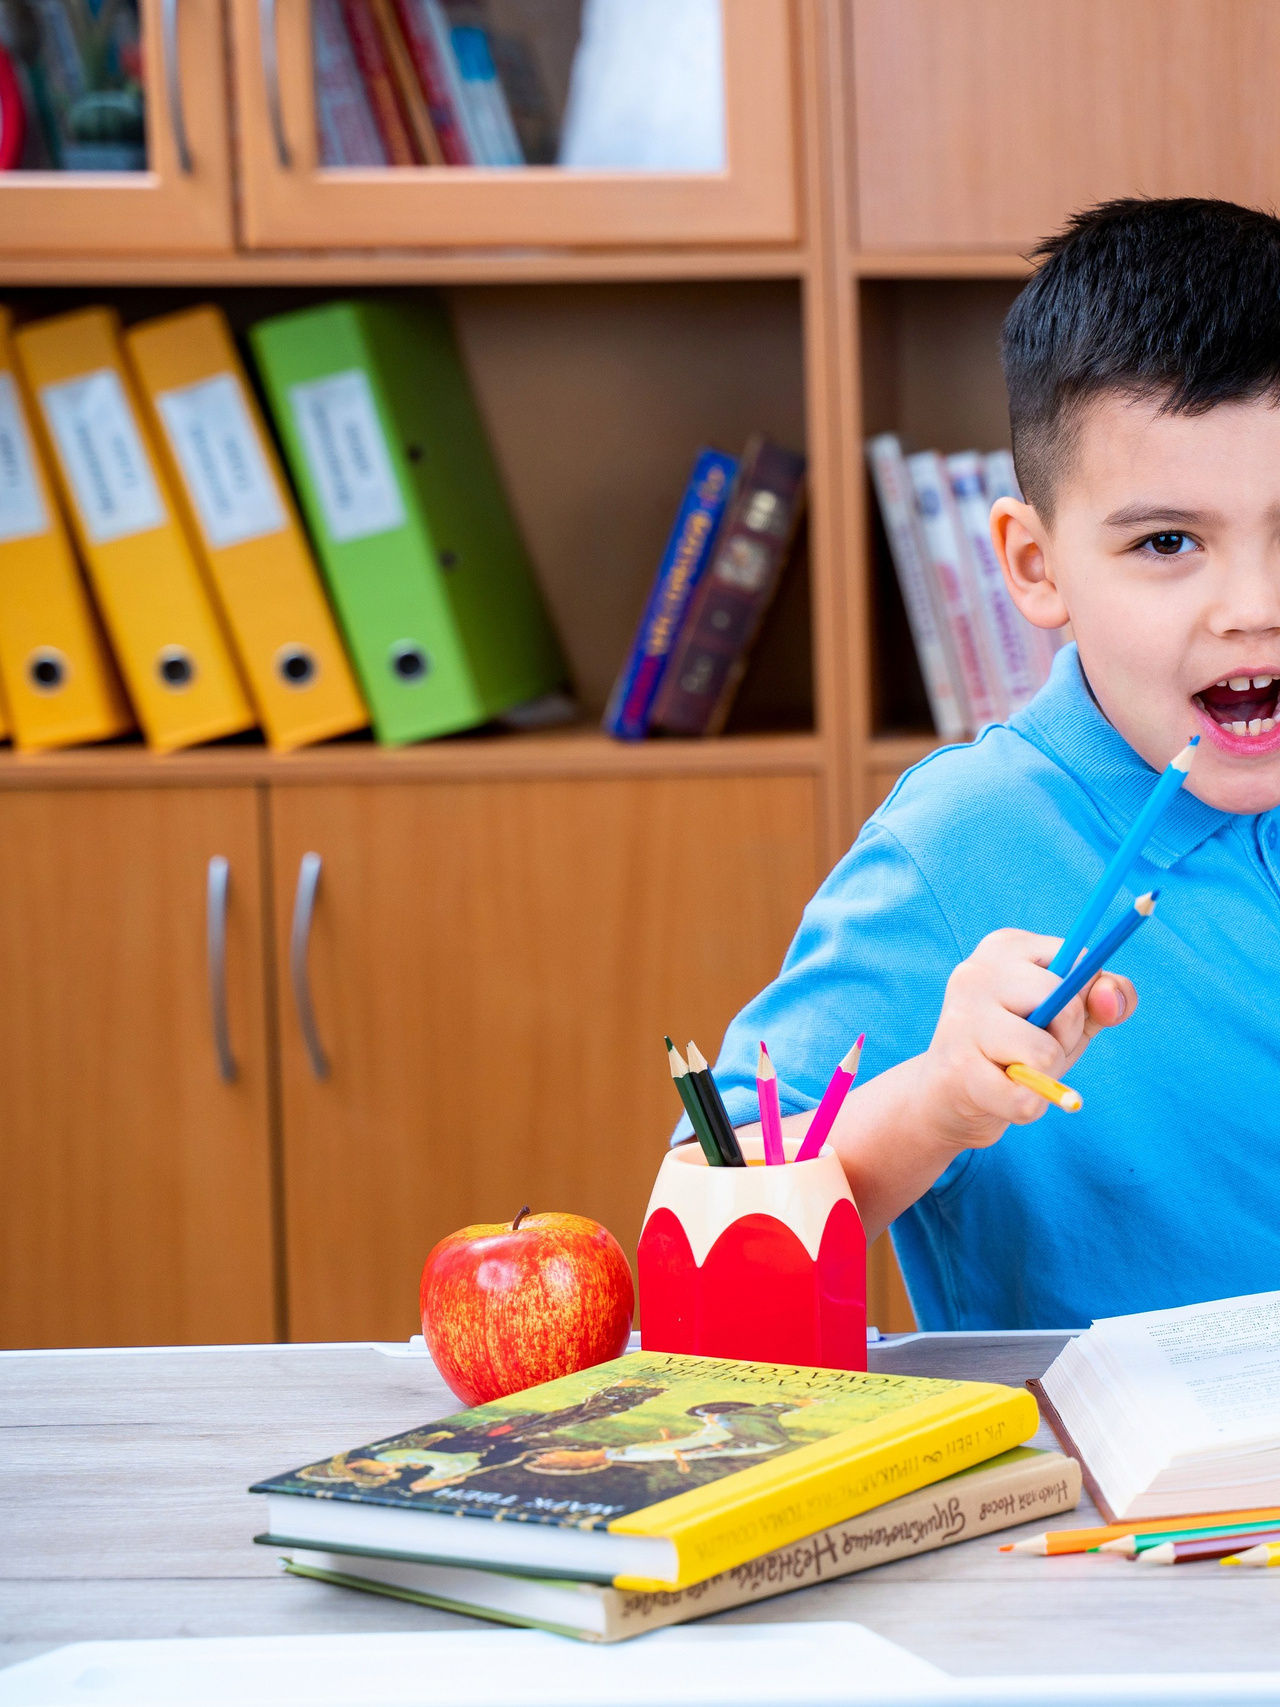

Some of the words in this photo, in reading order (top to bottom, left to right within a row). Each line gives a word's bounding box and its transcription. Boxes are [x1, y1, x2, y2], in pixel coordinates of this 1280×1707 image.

[812, 1371, 906, 1388] ТОМА
[979, 1493, 1016, 1521] Носов
[842, 1497, 966, 1556] Приключения
